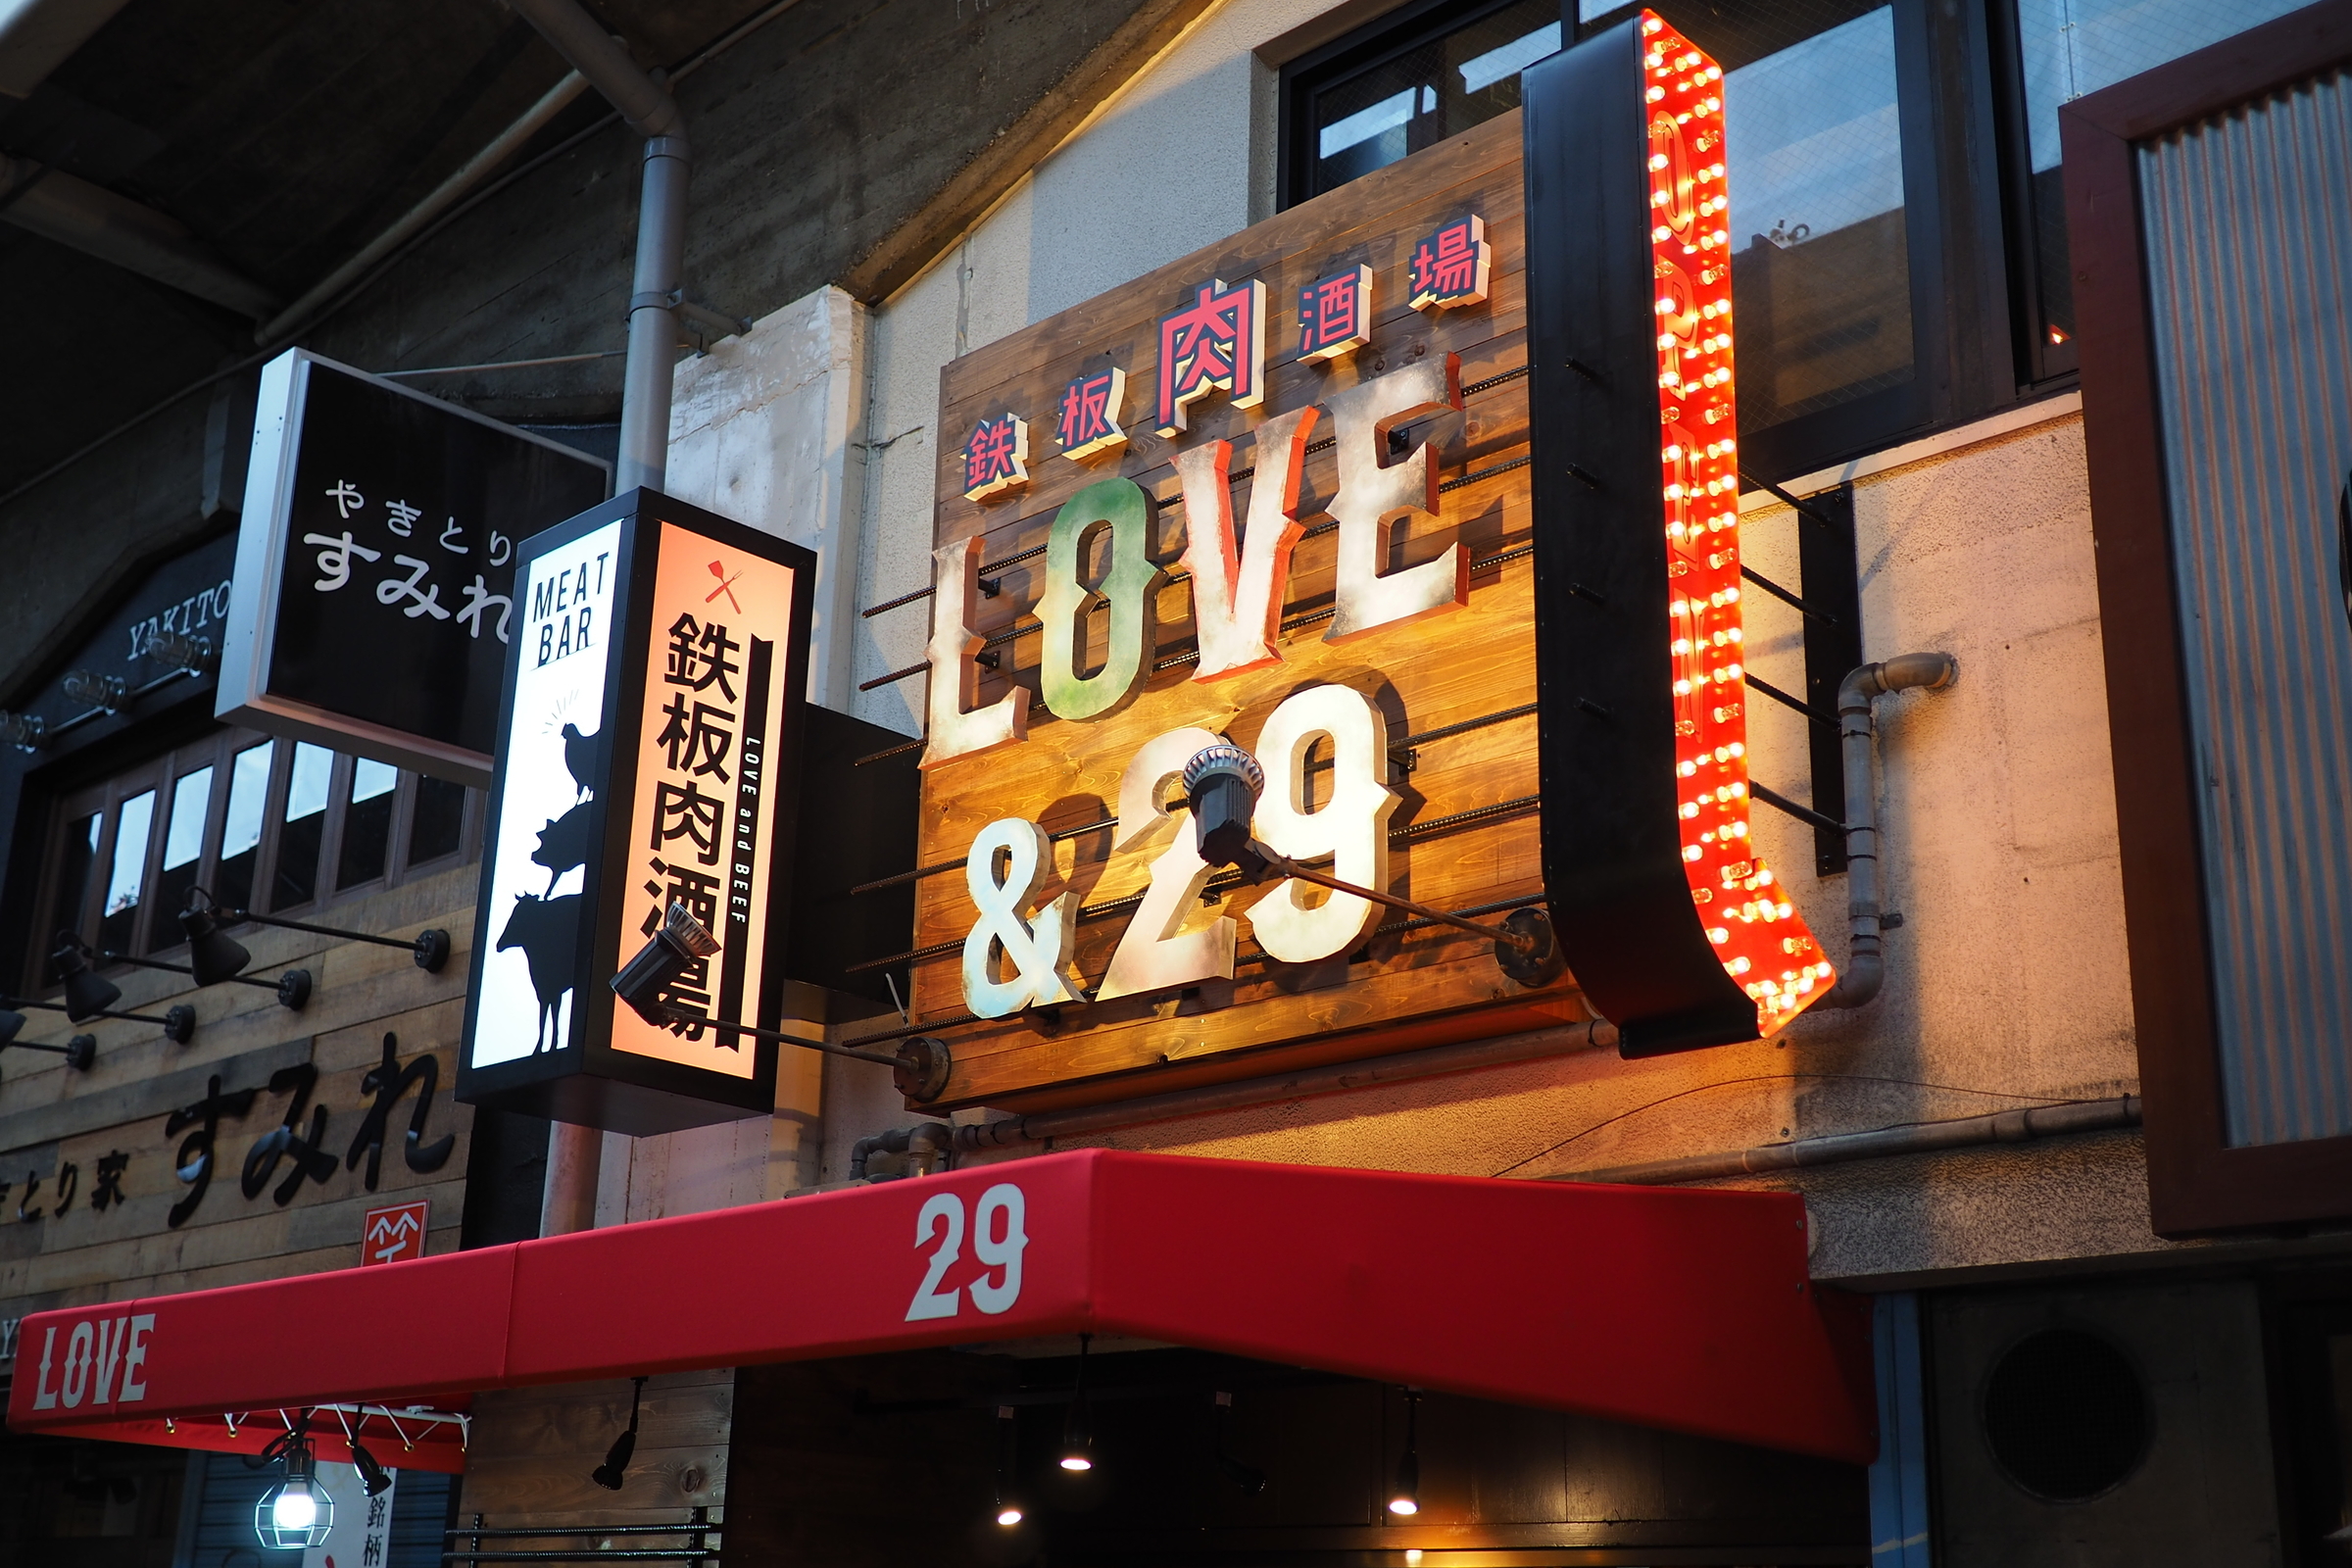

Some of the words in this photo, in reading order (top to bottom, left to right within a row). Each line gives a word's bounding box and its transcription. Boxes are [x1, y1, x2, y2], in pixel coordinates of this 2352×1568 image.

[962, 216, 1490, 500] 鉄板肉酒場
[325, 479, 513, 566] やきとり
[919, 353, 1468, 770] LOVE
[304, 531, 514, 644] すみれ
[533, 551, 610, 623] MEAT
[537, 606, 592, 668] BAR
[741, 736, 761, 797] LOVE
[737, 808, 752, 852] and
[962, 816, 1088, 1019] &
[1094, 683, 1403, 1002] 29
[731, 862, 751, 924] BEEF
[167, 1032, 454, 1227] すみれ
[905, 1183, 1029, 1322] 29
[31, 1313, 157, 1411] LOVE
